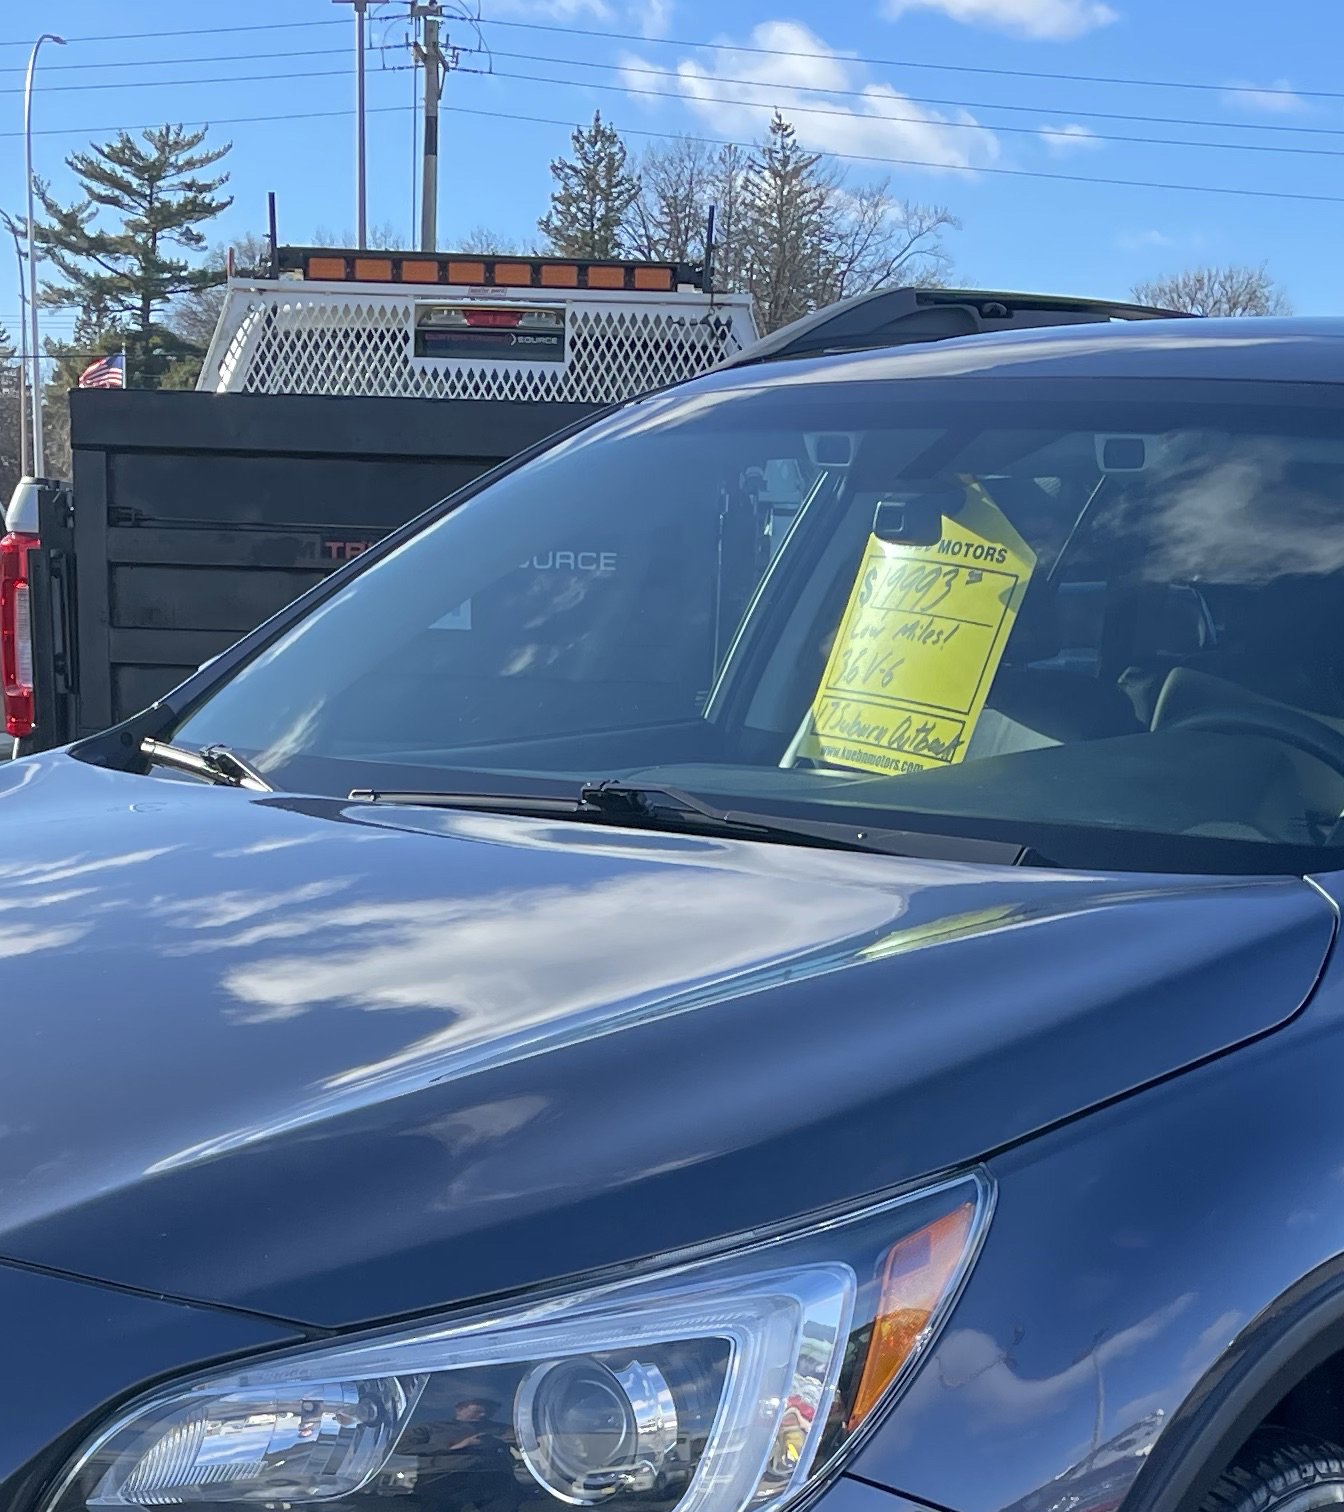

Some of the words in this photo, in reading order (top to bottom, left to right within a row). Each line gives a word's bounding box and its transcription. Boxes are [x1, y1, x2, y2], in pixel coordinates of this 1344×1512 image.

[324, 541, 372, 560] TR
[937, 539, 1008, 564] MOTORS
[519, 551, 618, 571] URCE
